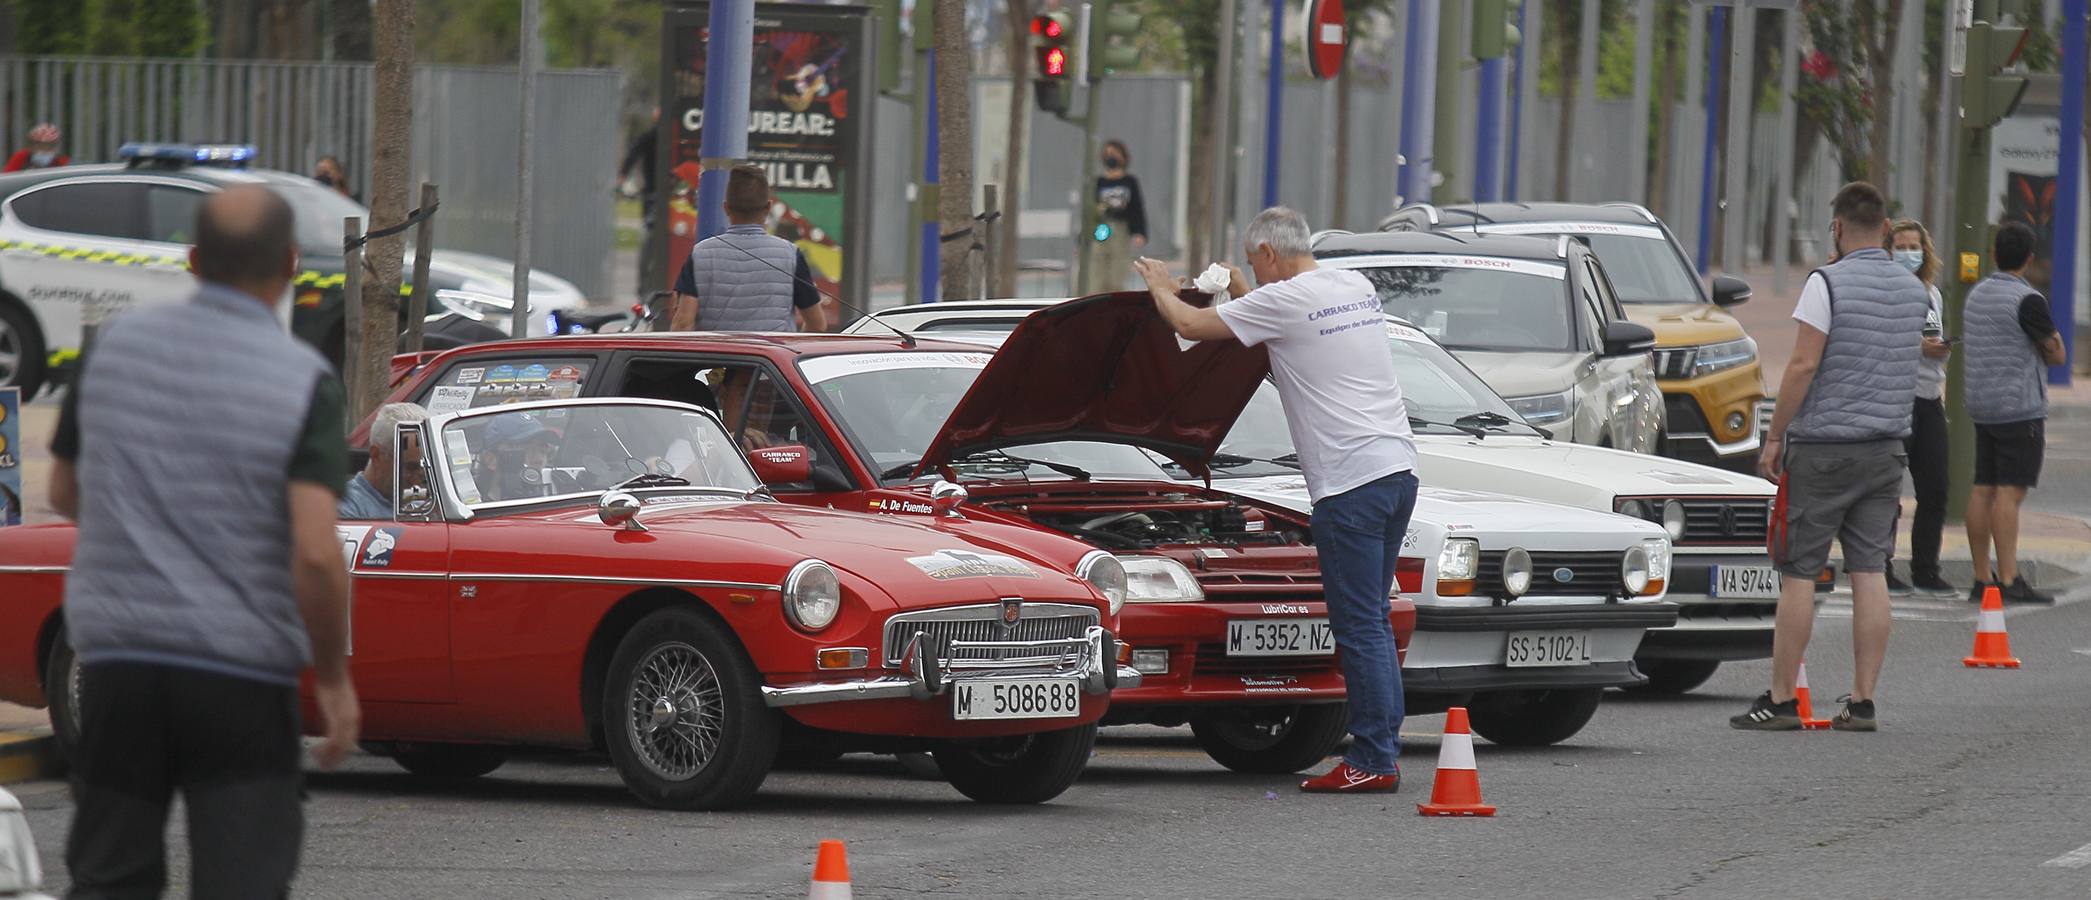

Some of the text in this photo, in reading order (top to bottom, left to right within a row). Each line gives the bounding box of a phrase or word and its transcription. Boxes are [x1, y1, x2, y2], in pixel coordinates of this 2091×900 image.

[683, 108, 835, 136] CUREAR:
[1464, 259, 1511, 268] BOSCH
[1308, 303, 1358, 321] CARRASCO
[1320, 324, 1350, 336] Equipo
[1351, 320, 1360, 328] de
[880, 499, 933, 514] A. De Fuentes
[1721, 569, 1737, 592] VA
[1741, 569, 1773, 593] 9744
[958, 683, 1076, 714] M 508688
